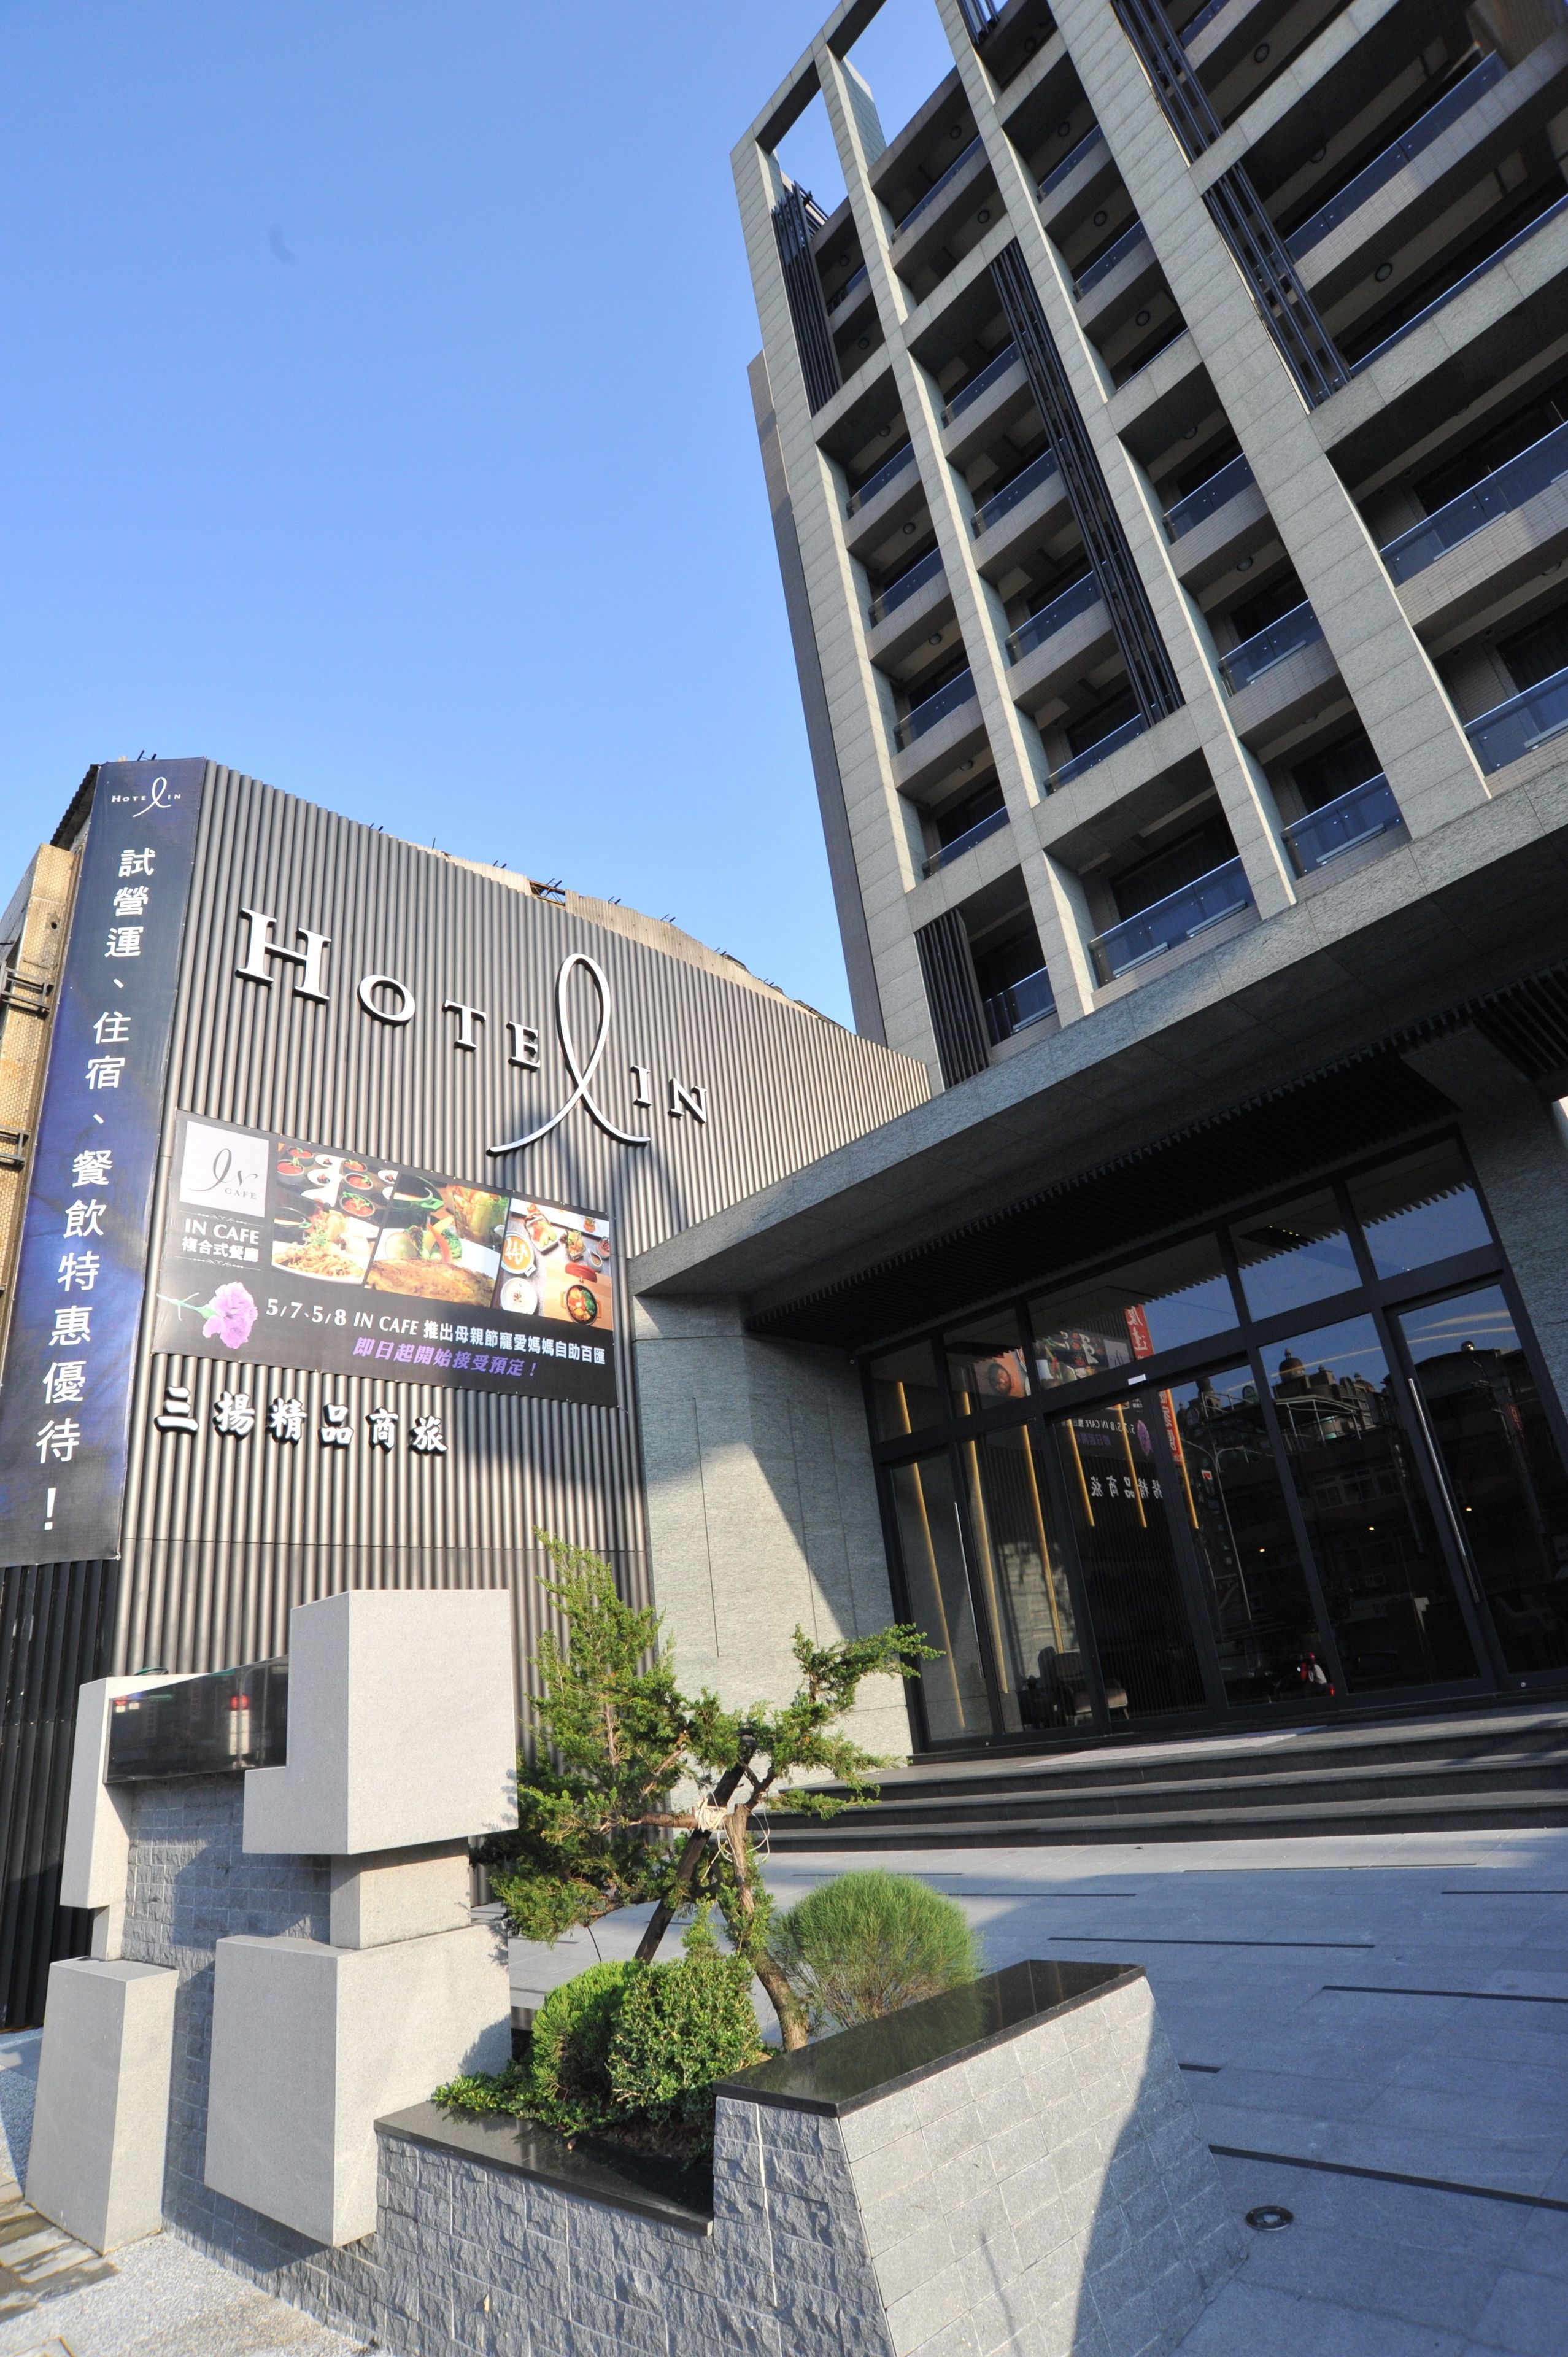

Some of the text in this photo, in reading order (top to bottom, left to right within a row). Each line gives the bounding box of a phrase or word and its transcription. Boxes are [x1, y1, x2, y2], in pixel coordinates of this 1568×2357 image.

[630, 1064, 708, 1124] IN
[224, 1188, 257, 1200] CAFE
[181, 1236, 259, 1263] 複合式餐廳
[185, 1218, 260, 1245] IN CAFE
[353, 1311, 374, 1329] IN
[379, 1315, 419, 1336] CAFE
[423, 1320, 606, 1366] 推出母親節寵愛媽媽自助百匯
[156, 1385, 448, 1453] 三揚精品商旅
